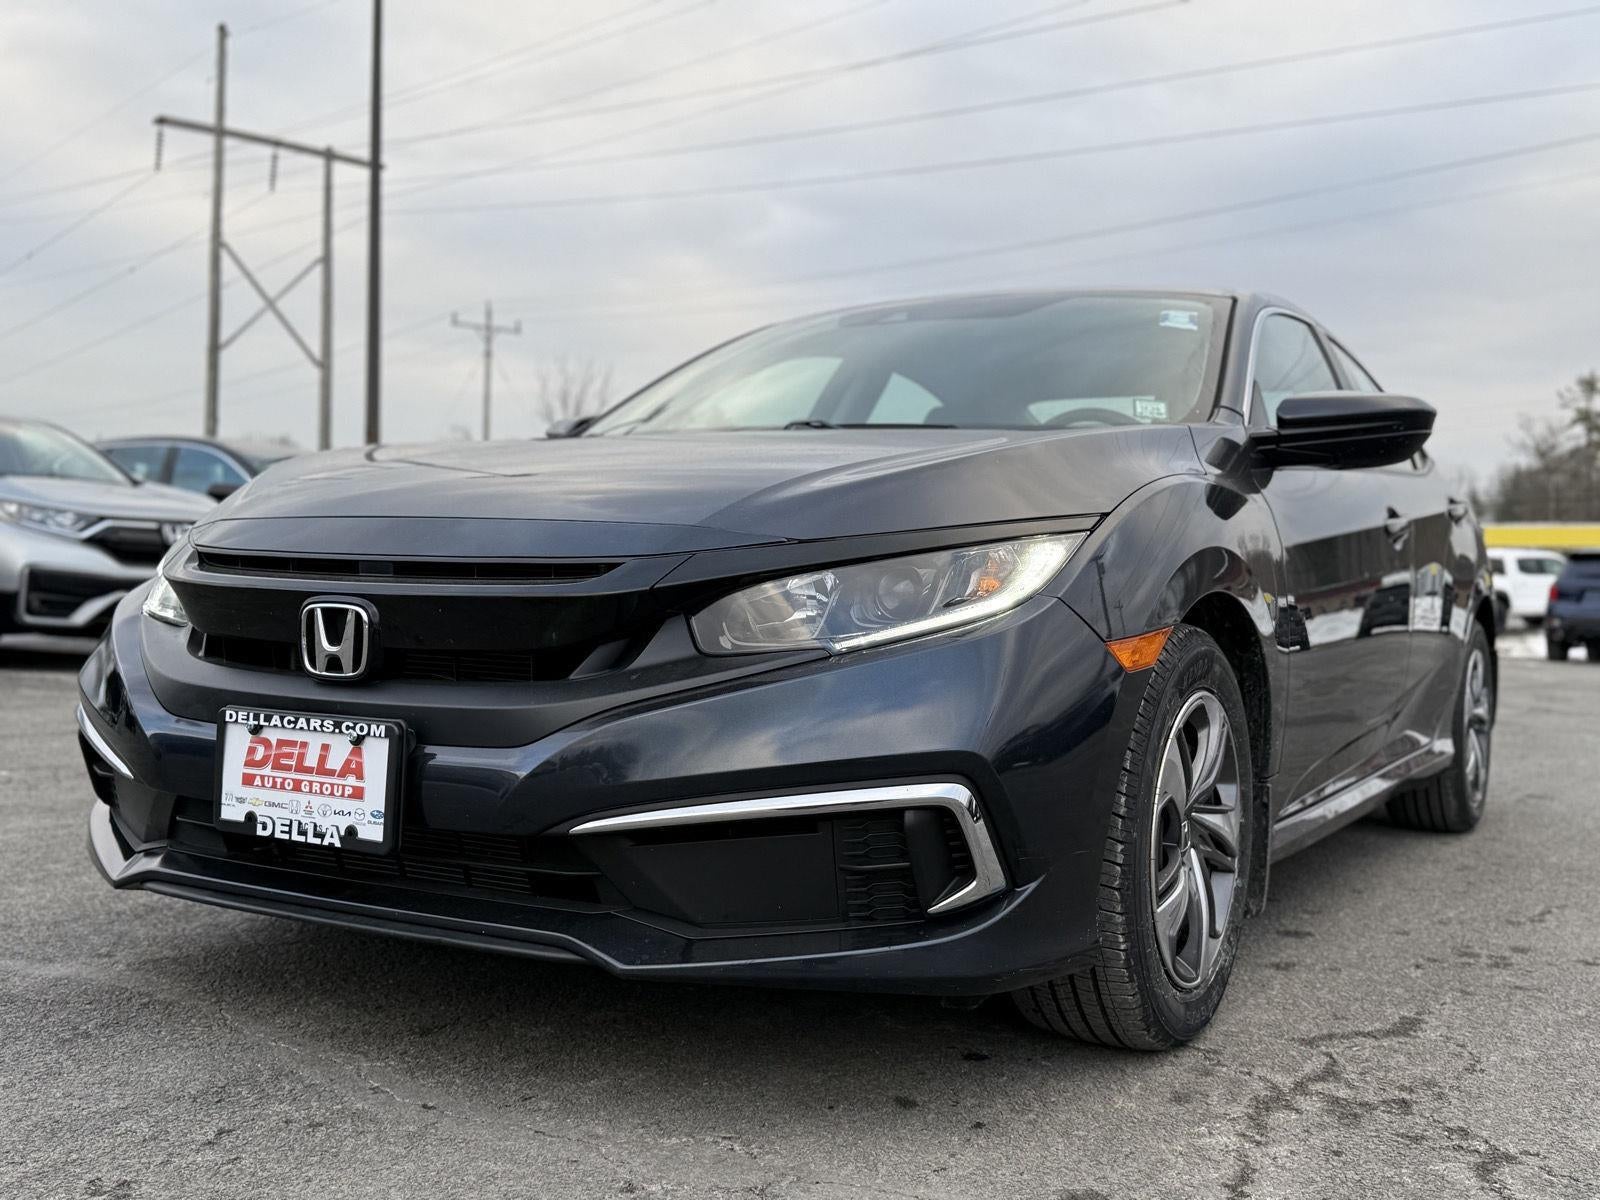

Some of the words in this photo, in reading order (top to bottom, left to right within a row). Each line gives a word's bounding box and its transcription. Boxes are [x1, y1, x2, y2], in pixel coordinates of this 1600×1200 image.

[225, 710, 386, 738] DELLACARS.COM
[243, 735, 366, 783] DELLA
[253, 774, 294, 789] AUTO
[301, 781, 353, 798] GROUP
[264, 800, 289, 810] GMC
[256, 814, 342, 848] DELLA
